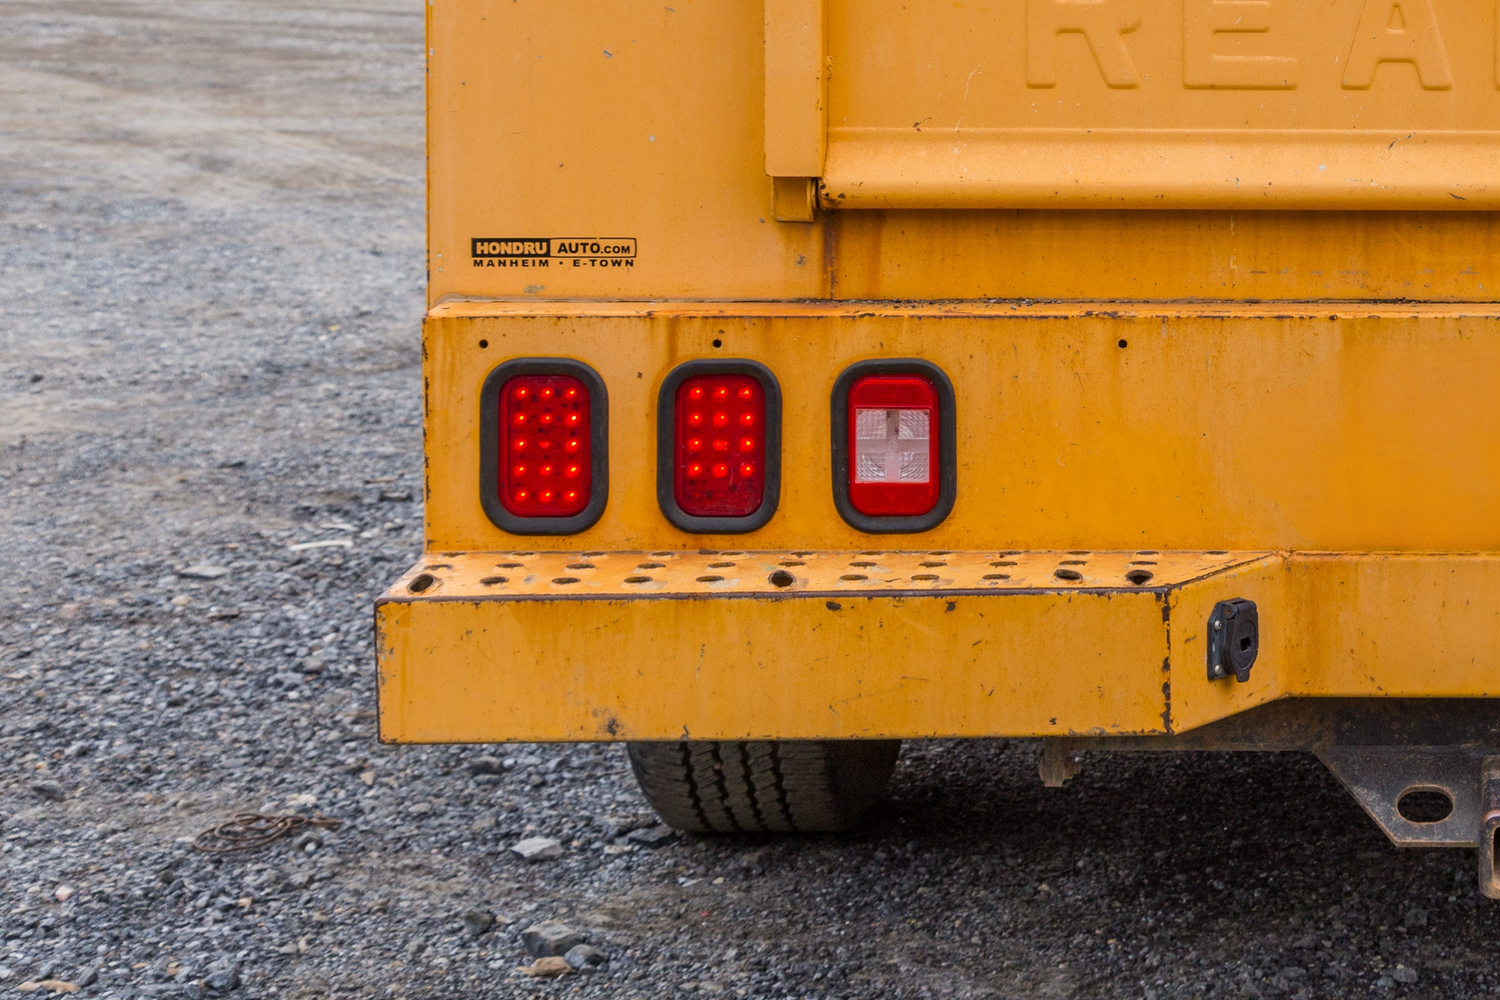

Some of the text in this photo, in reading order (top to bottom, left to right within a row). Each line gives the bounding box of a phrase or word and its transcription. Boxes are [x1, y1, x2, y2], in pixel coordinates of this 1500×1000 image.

[476, 241, 547, 255] HONDRU
[473, 259, 634, 267] MANHEIM E-TOWN
